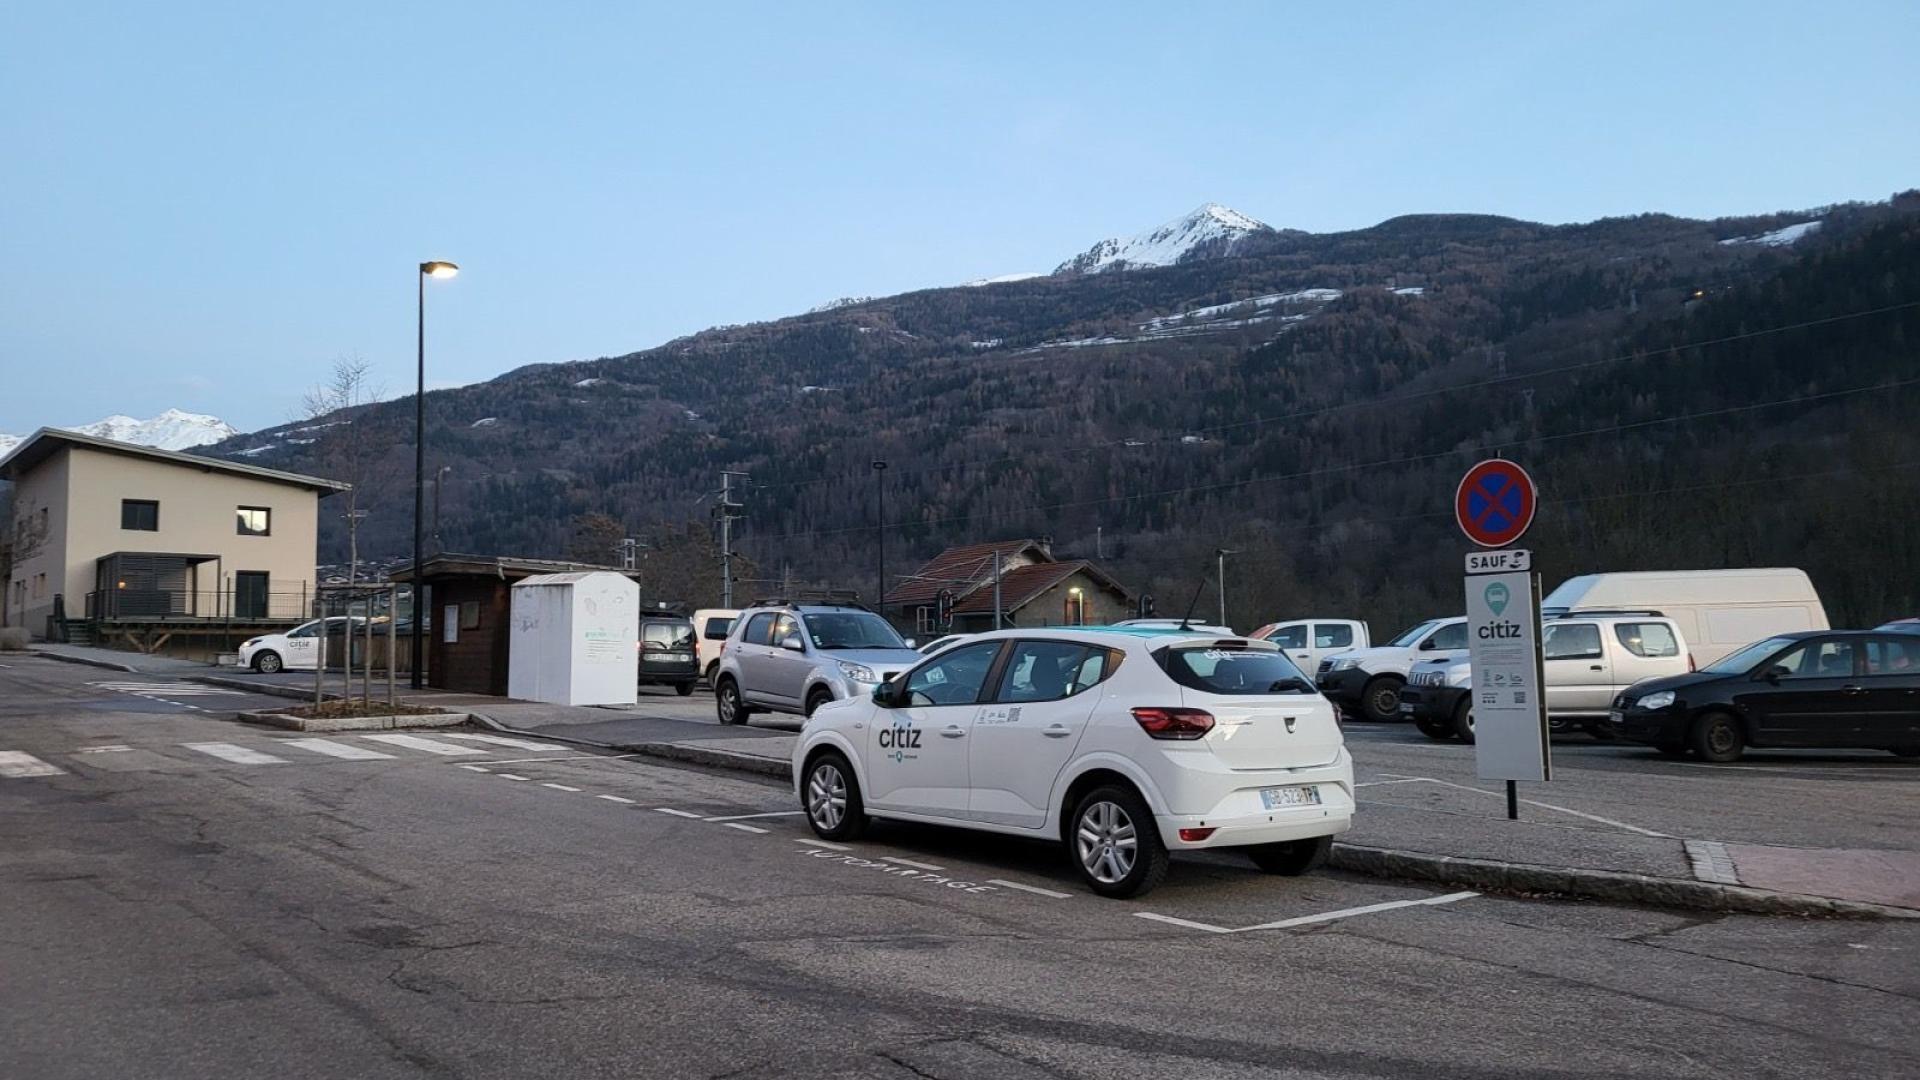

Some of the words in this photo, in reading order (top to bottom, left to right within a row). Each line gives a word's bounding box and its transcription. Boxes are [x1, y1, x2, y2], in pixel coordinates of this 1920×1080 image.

[1470, 555, 1507, 568] SAUF
[1478, 620, 1522, 639] citiz
[879, 722, 922, 749] citiz
